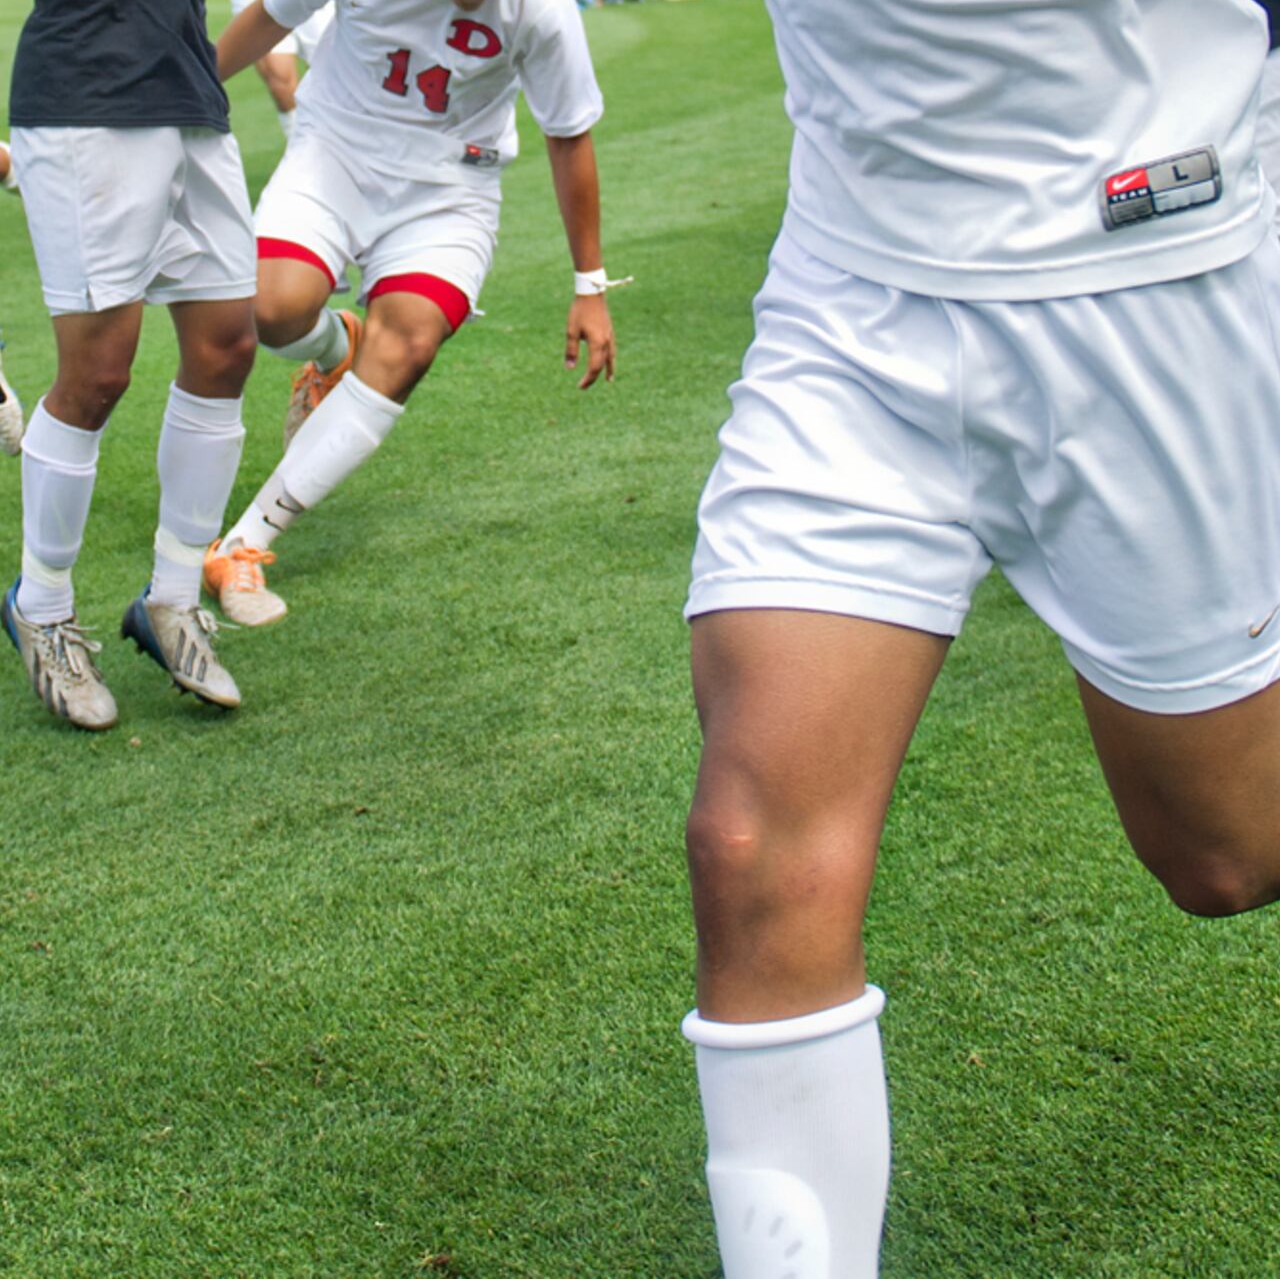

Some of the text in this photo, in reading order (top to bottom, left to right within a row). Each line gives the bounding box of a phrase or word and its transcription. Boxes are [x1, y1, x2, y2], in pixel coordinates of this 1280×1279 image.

[445, 18, 503, 59] D
[382, 48, 452, 114] 14
[1172, 164, 1189, 182] L
